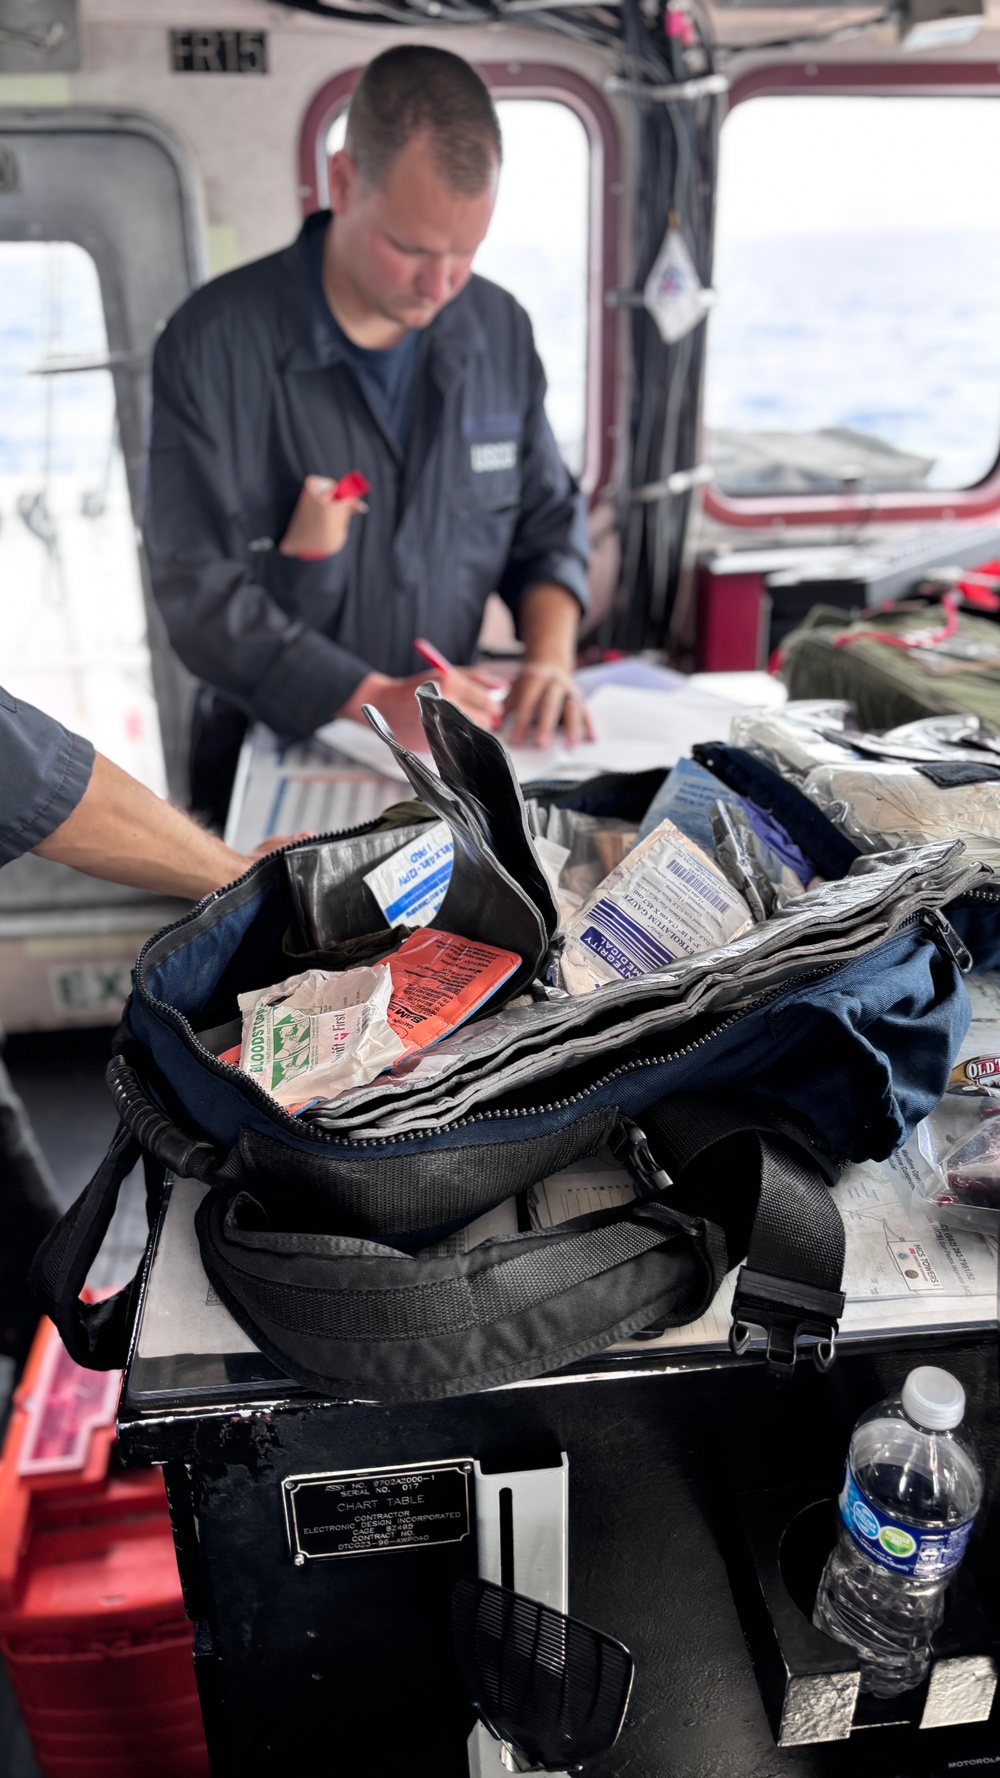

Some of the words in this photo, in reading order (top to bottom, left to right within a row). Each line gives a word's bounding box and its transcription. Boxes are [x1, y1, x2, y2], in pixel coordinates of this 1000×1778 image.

[172, 30, 267, 73] FR15
[410, 847, 427, 863] PAD
[622, 894, 647, 915] GAUZE
[648, 915, 694, 955] ETROLATUM
[585, 937, 633, 978] NTEGRITY
[601, 937, 641, 976] MEDICAL
[332, 1013, 345, 1030] First
[395, 1008, 421, 1024] SAM
[250, 1003, 267, 1072] BLOODSTOPP
[968, 1062, 995, 1078] OLD
[913, 1244, 925, 1257] MCS
[921, 1258, 938, 1282] TOWERS
[340, 1490, 370, 1498] SERIAL
[401, 1483, 419, 1491] 017
[337, 1499, 378, 1512] CHART
[386, 1494, 425, 1506] TABLE
[303, 1523, 355, 1535] ELECTRONIC
[361, 1519, 392, 1528] DESIGN
[397, 1511, 461, 1524] INCORPORATED
[354, 1511, 410, 1522] CONTRACTOR
[351, 1531, 395, 1542] CONTRACT
[352, 1527, 375, 1536] CAGE
